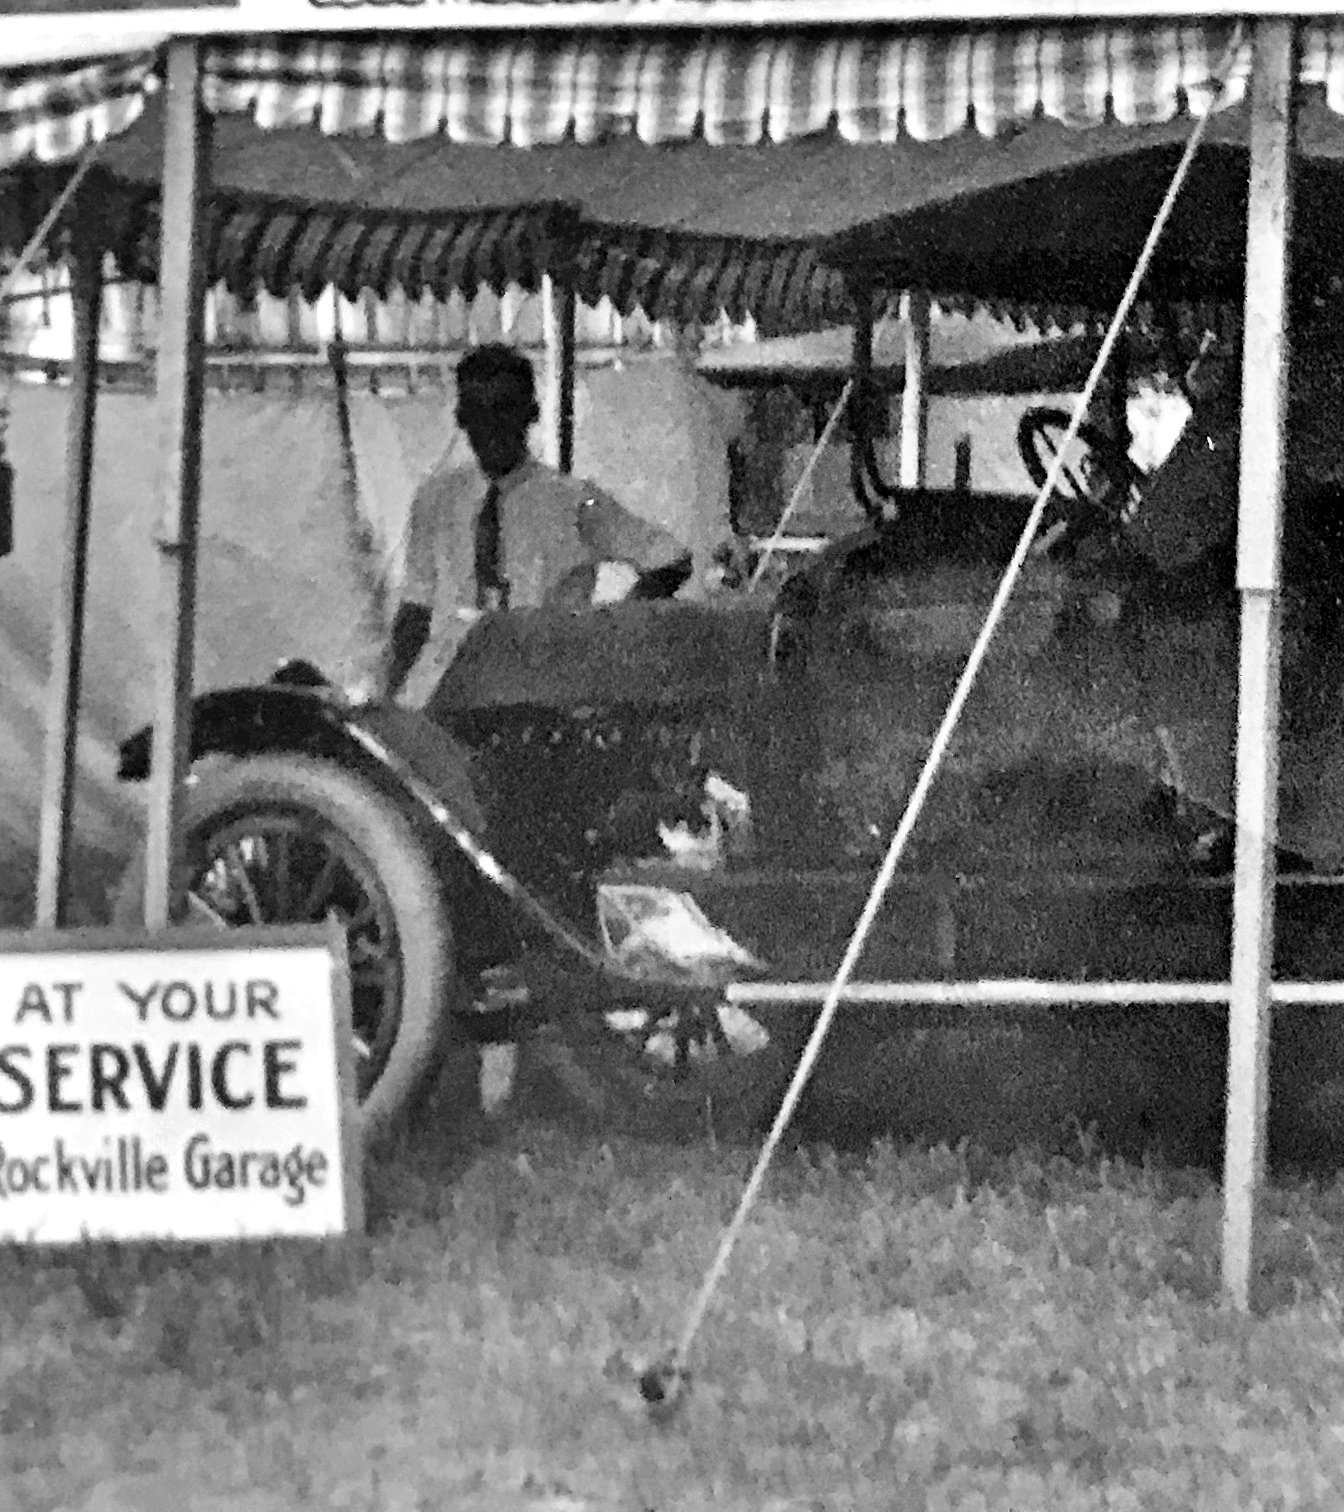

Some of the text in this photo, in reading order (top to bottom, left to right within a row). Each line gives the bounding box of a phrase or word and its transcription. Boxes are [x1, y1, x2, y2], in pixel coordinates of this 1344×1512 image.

[15, 979, 282, 1025] AT YOUR
[184, 1133, 329, 1206] Garage
